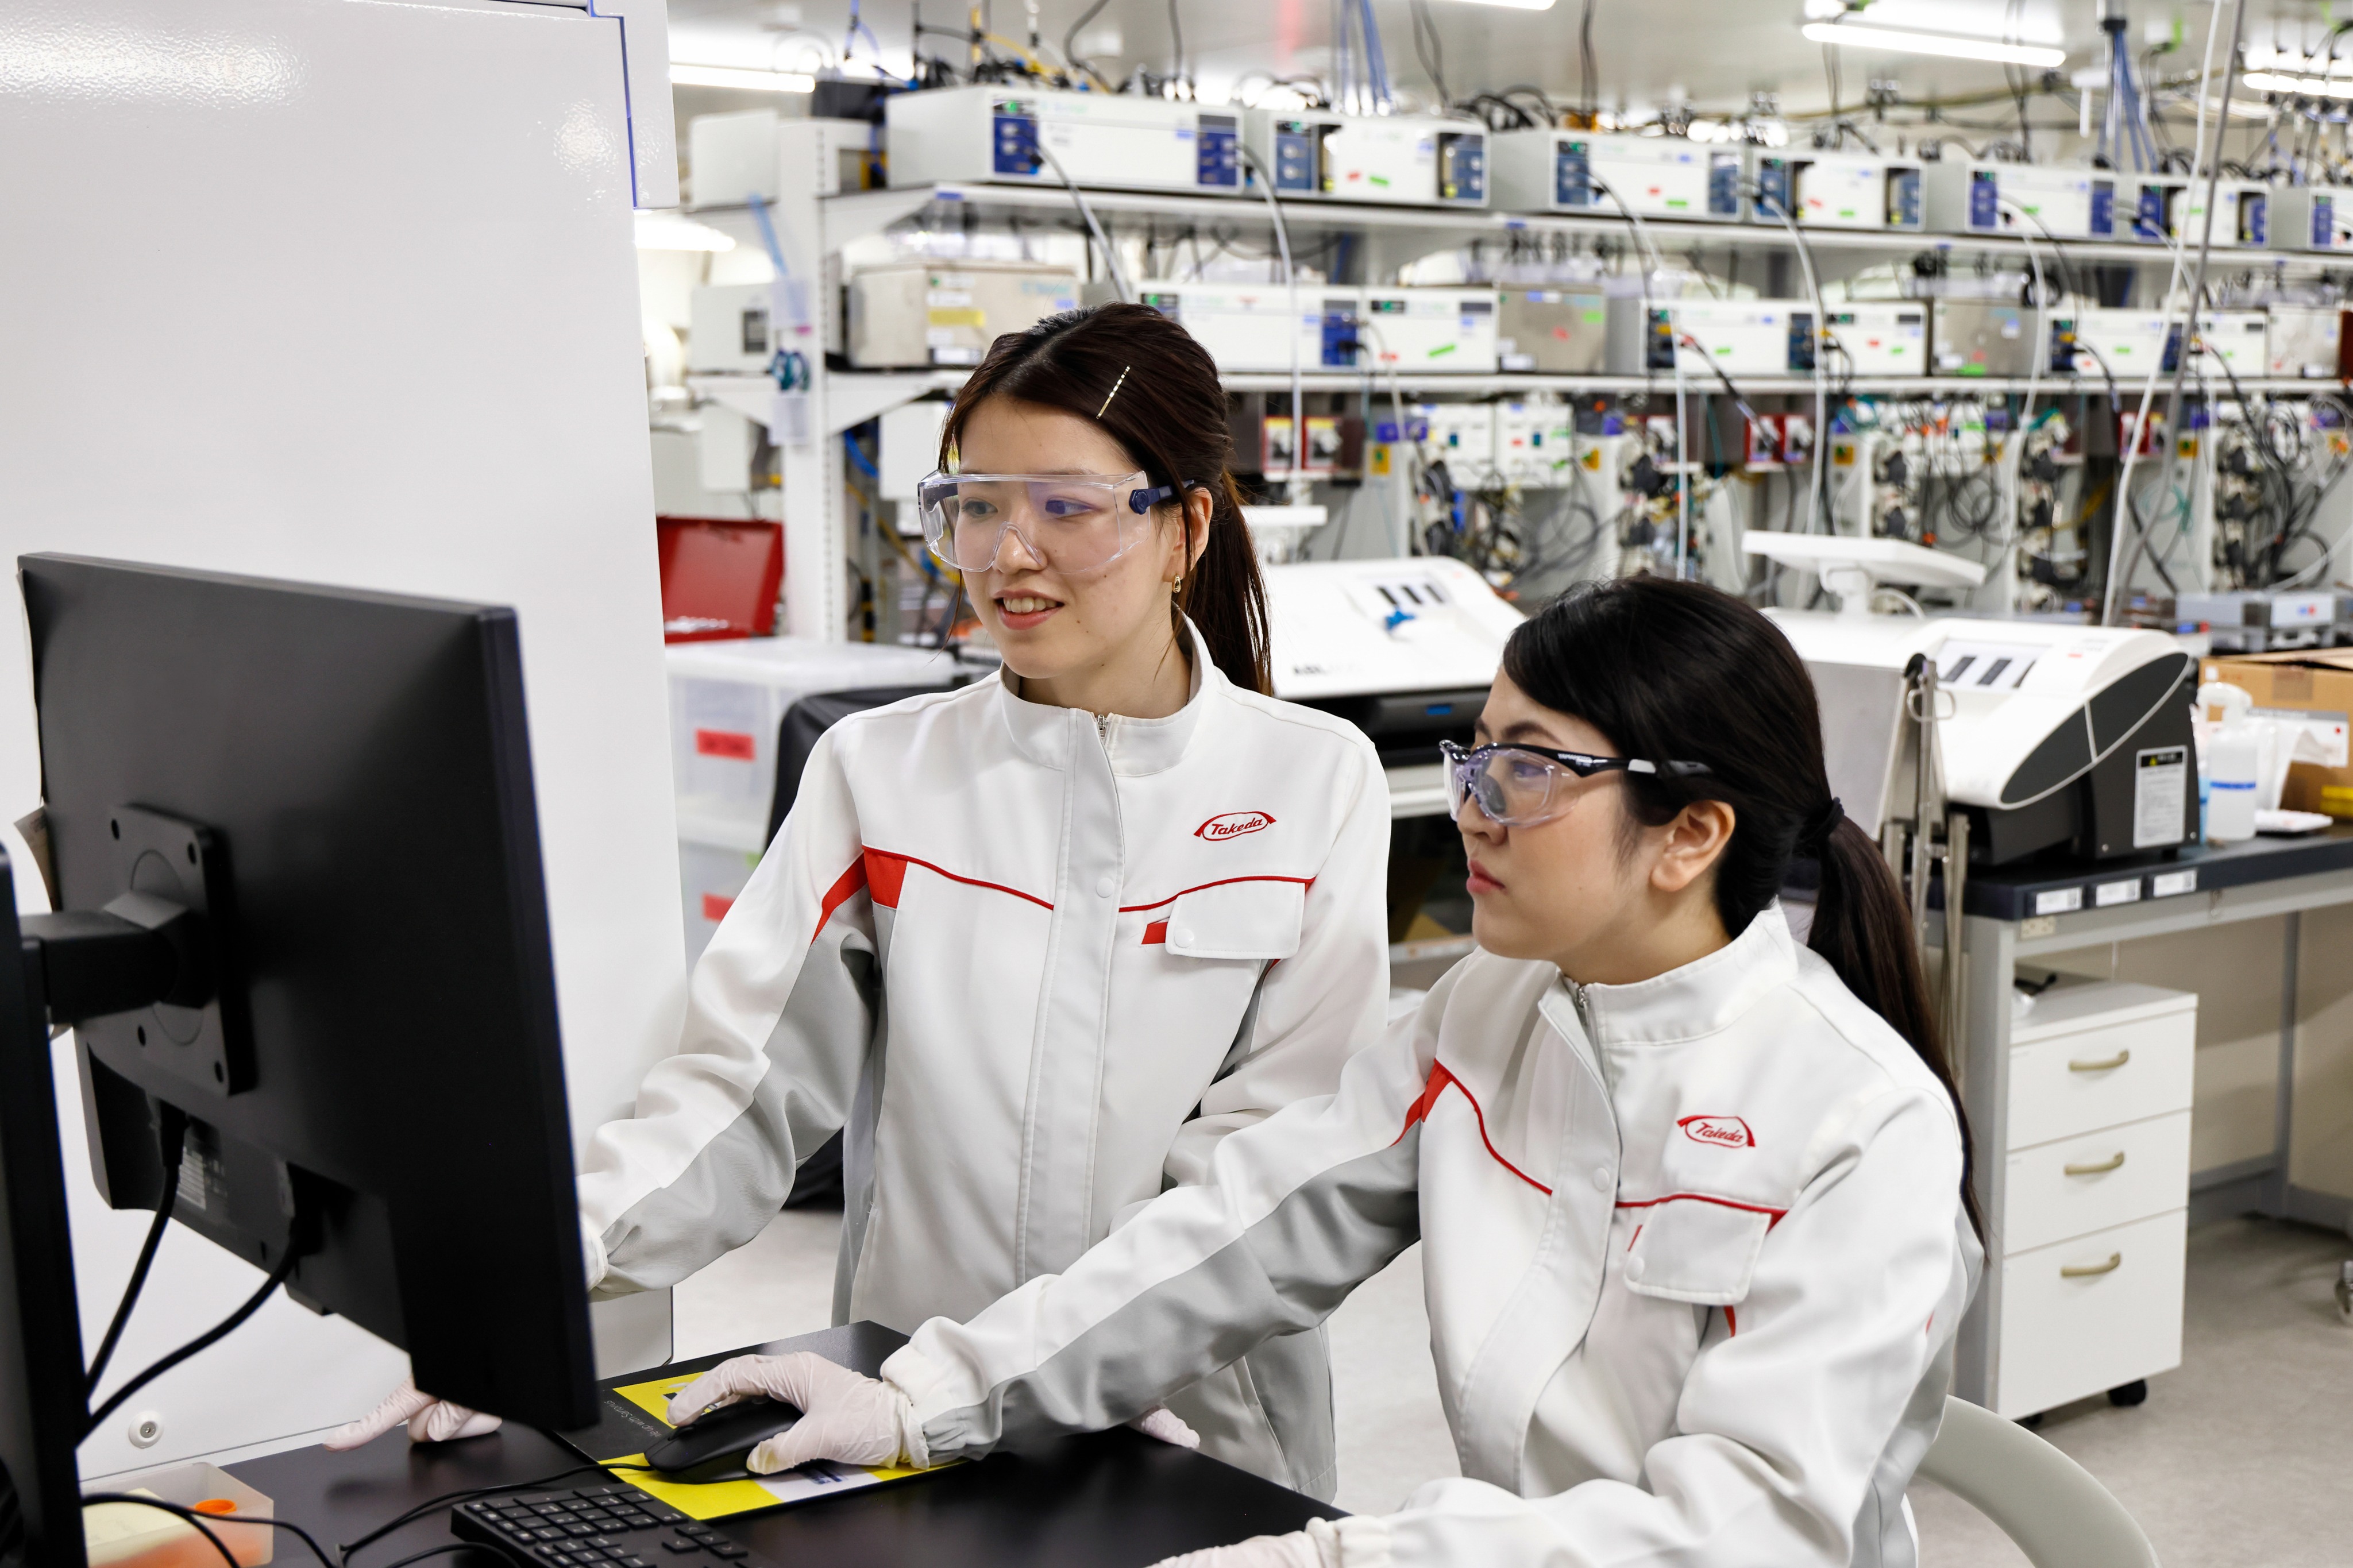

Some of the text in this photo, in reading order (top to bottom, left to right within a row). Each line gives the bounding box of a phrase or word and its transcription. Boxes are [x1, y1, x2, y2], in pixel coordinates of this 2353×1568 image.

[1212, 817, 1263, 835] Takeda
[1695, 1122, 1743, 1142] Takeda
[604, 1400, 632, 1418] Sartorius
